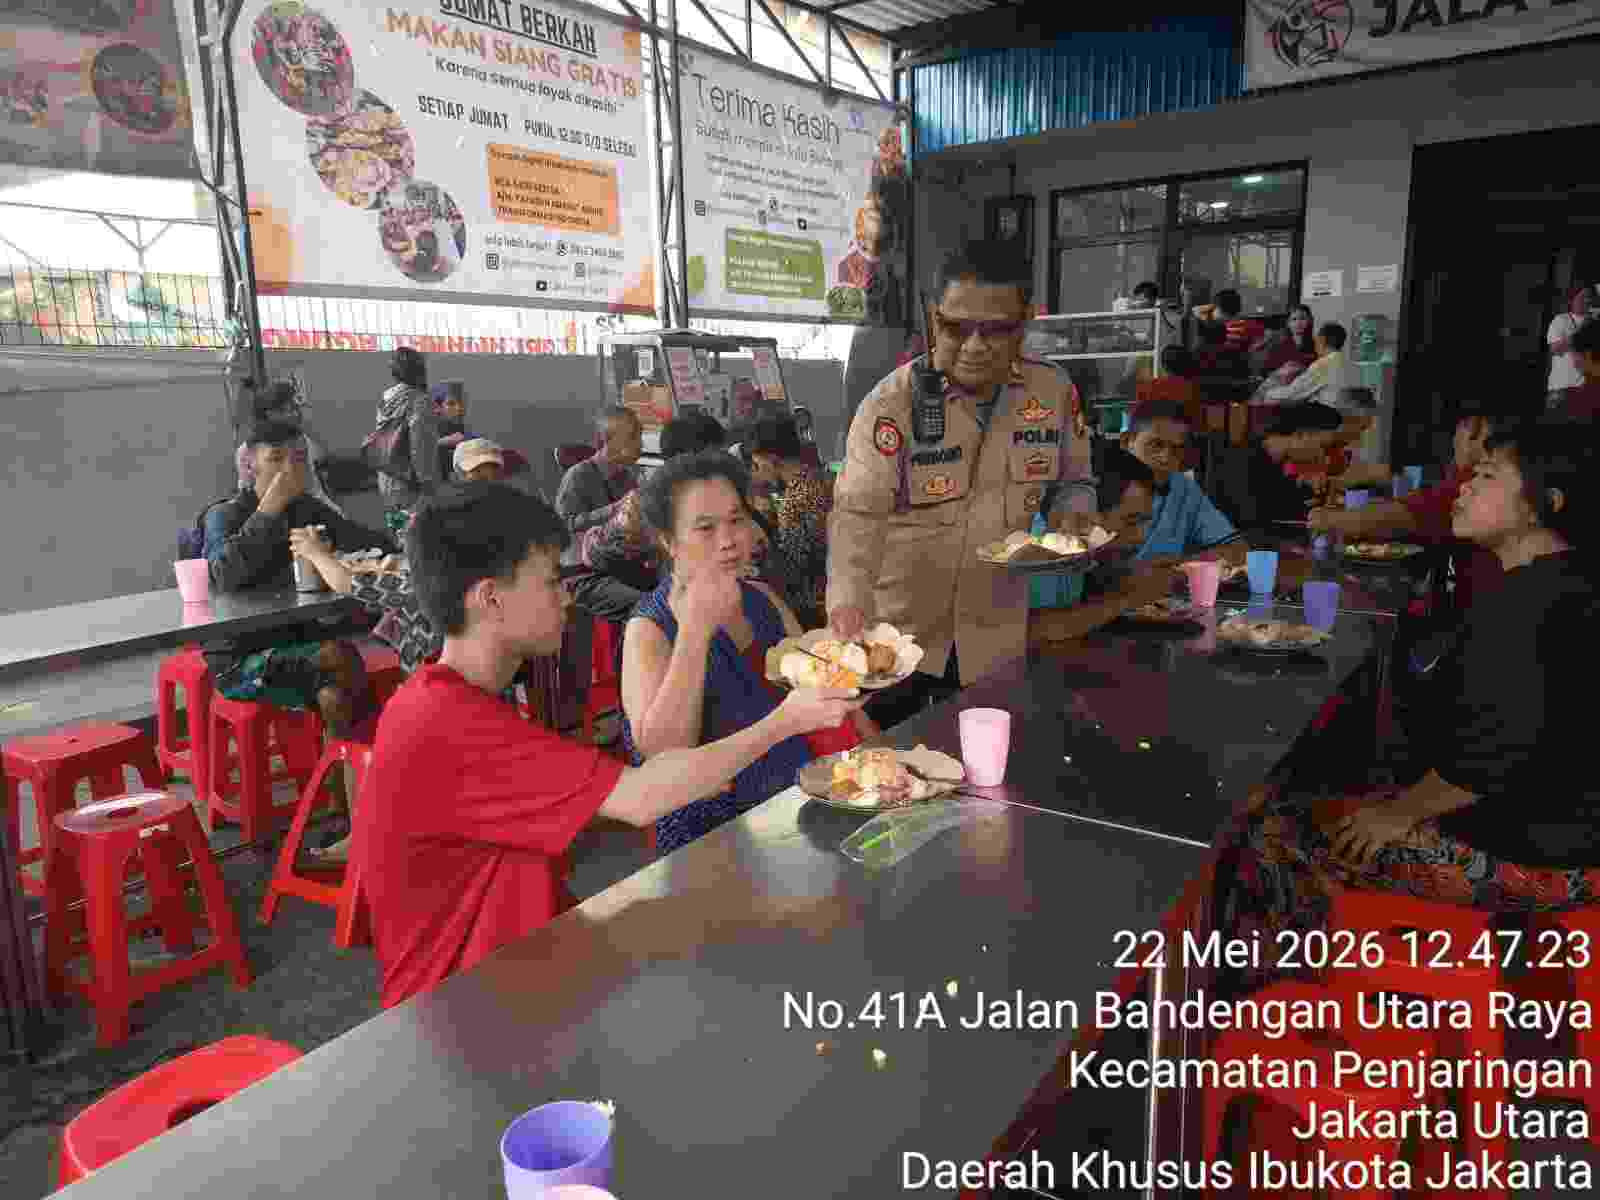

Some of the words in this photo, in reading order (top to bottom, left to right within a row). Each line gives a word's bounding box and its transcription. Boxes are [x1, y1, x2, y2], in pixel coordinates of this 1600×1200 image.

[385, 8, 487, 60] MAKAN
[494, 38, 561, 79] SIANG
[567, 60, 637, 98] GRATIS
[520, 5, 598, 54] BERKAH
[417, 95, 465, 121] SETIAP
[468, 105, 510, 133] JUMAT
[523, 119, 556, 141] PUKUL
[693, 73, 777, 128] Terima
[781, 104, 841, 145] Kasih
